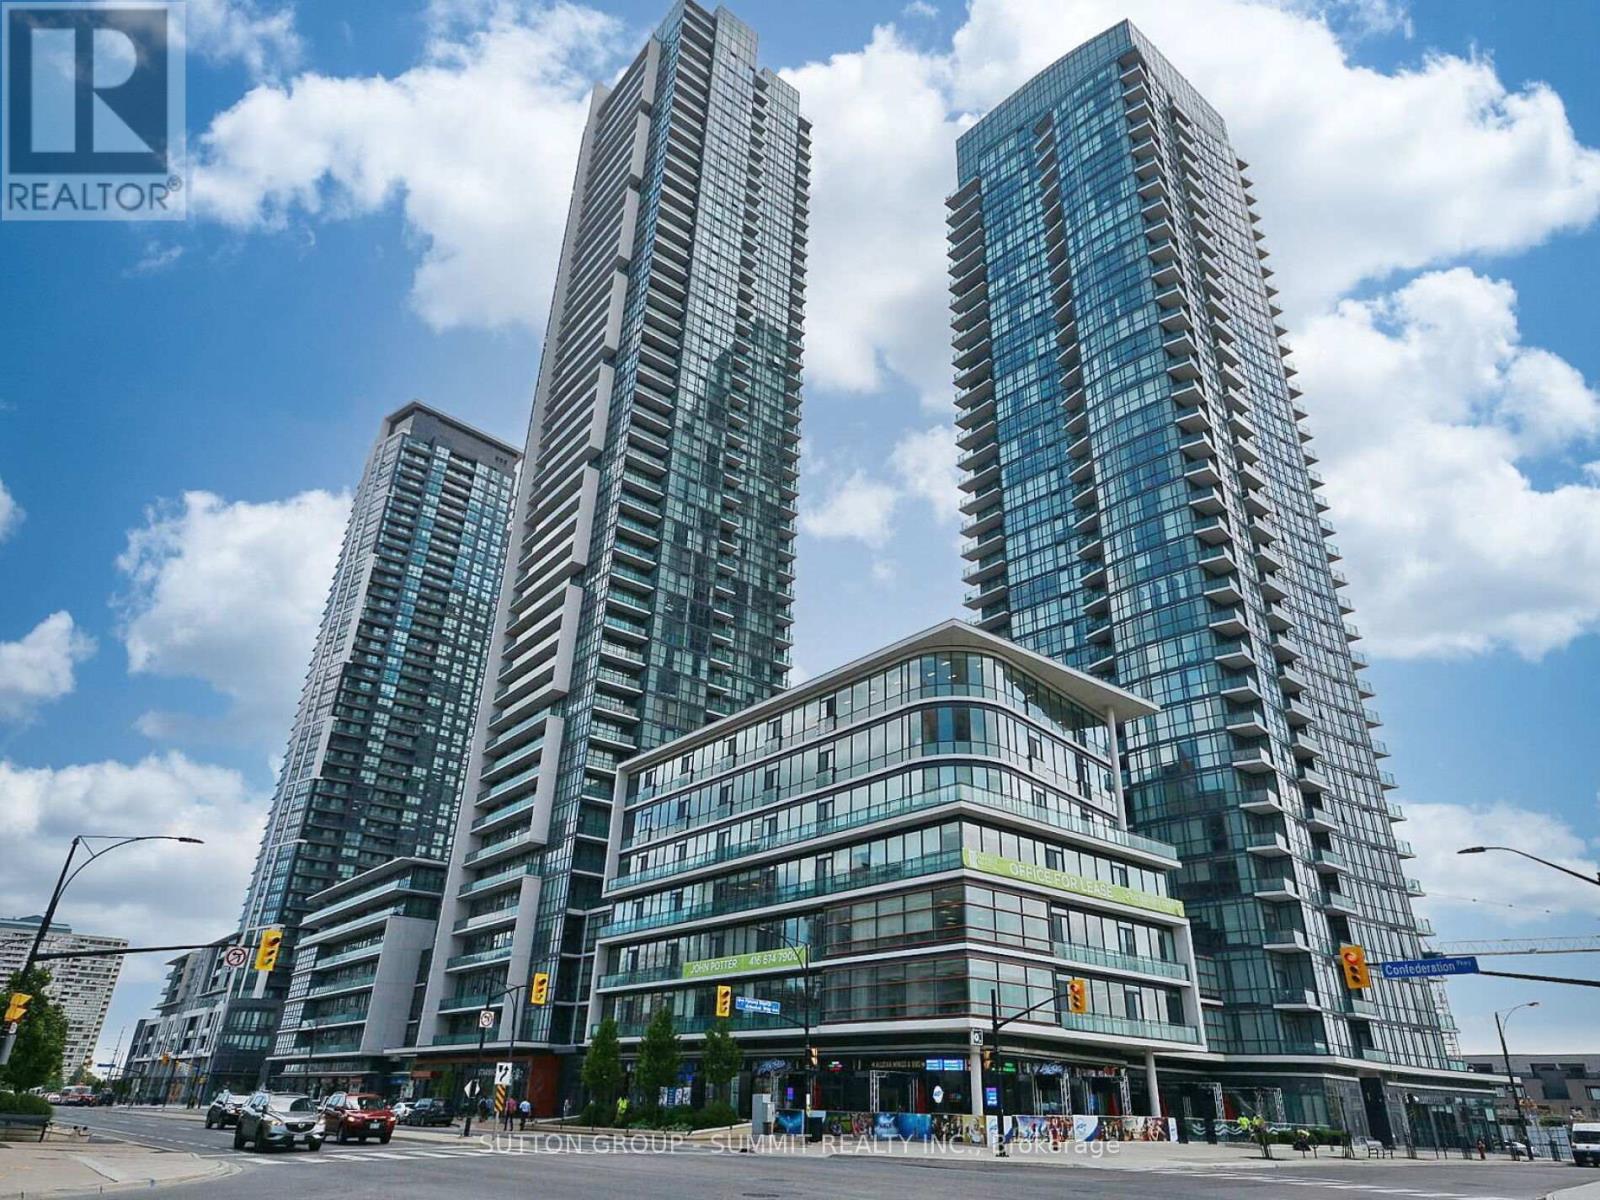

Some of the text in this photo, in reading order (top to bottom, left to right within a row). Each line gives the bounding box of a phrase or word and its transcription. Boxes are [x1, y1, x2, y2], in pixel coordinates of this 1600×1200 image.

[1009, 863, 1112, 898] OFFICE FOR LEASE
[691, 963, 709, 974] JOHN
[711, 959, 737, 971] POTTER
[1385, 962, 1456, 976] Confederation
